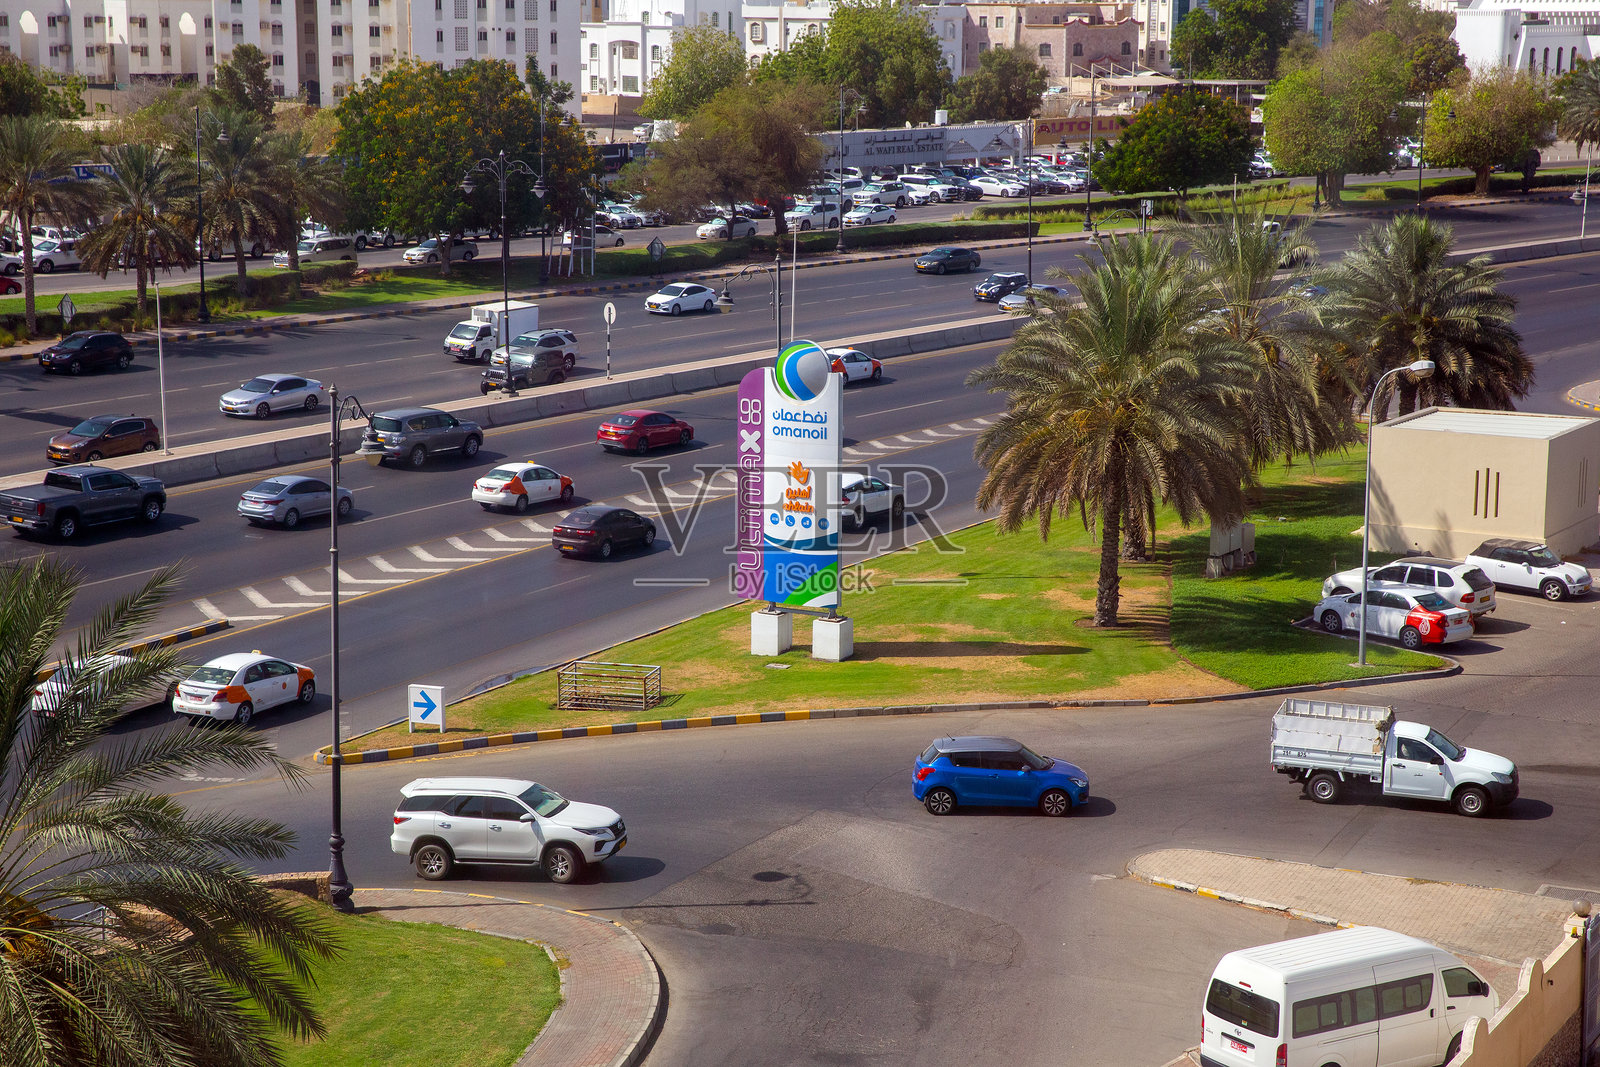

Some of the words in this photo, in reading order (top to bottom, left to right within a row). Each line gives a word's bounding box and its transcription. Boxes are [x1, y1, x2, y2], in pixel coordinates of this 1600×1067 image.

[865, 147, 875, 156] AL
[876, 146, 896, 156] WAFI
[896, 145, 915, 154] REAL
[917, 143, 944, 152] ESTATE
[739, 398, 762, 425] 98
[772, 425, 828, 440] omanoil
